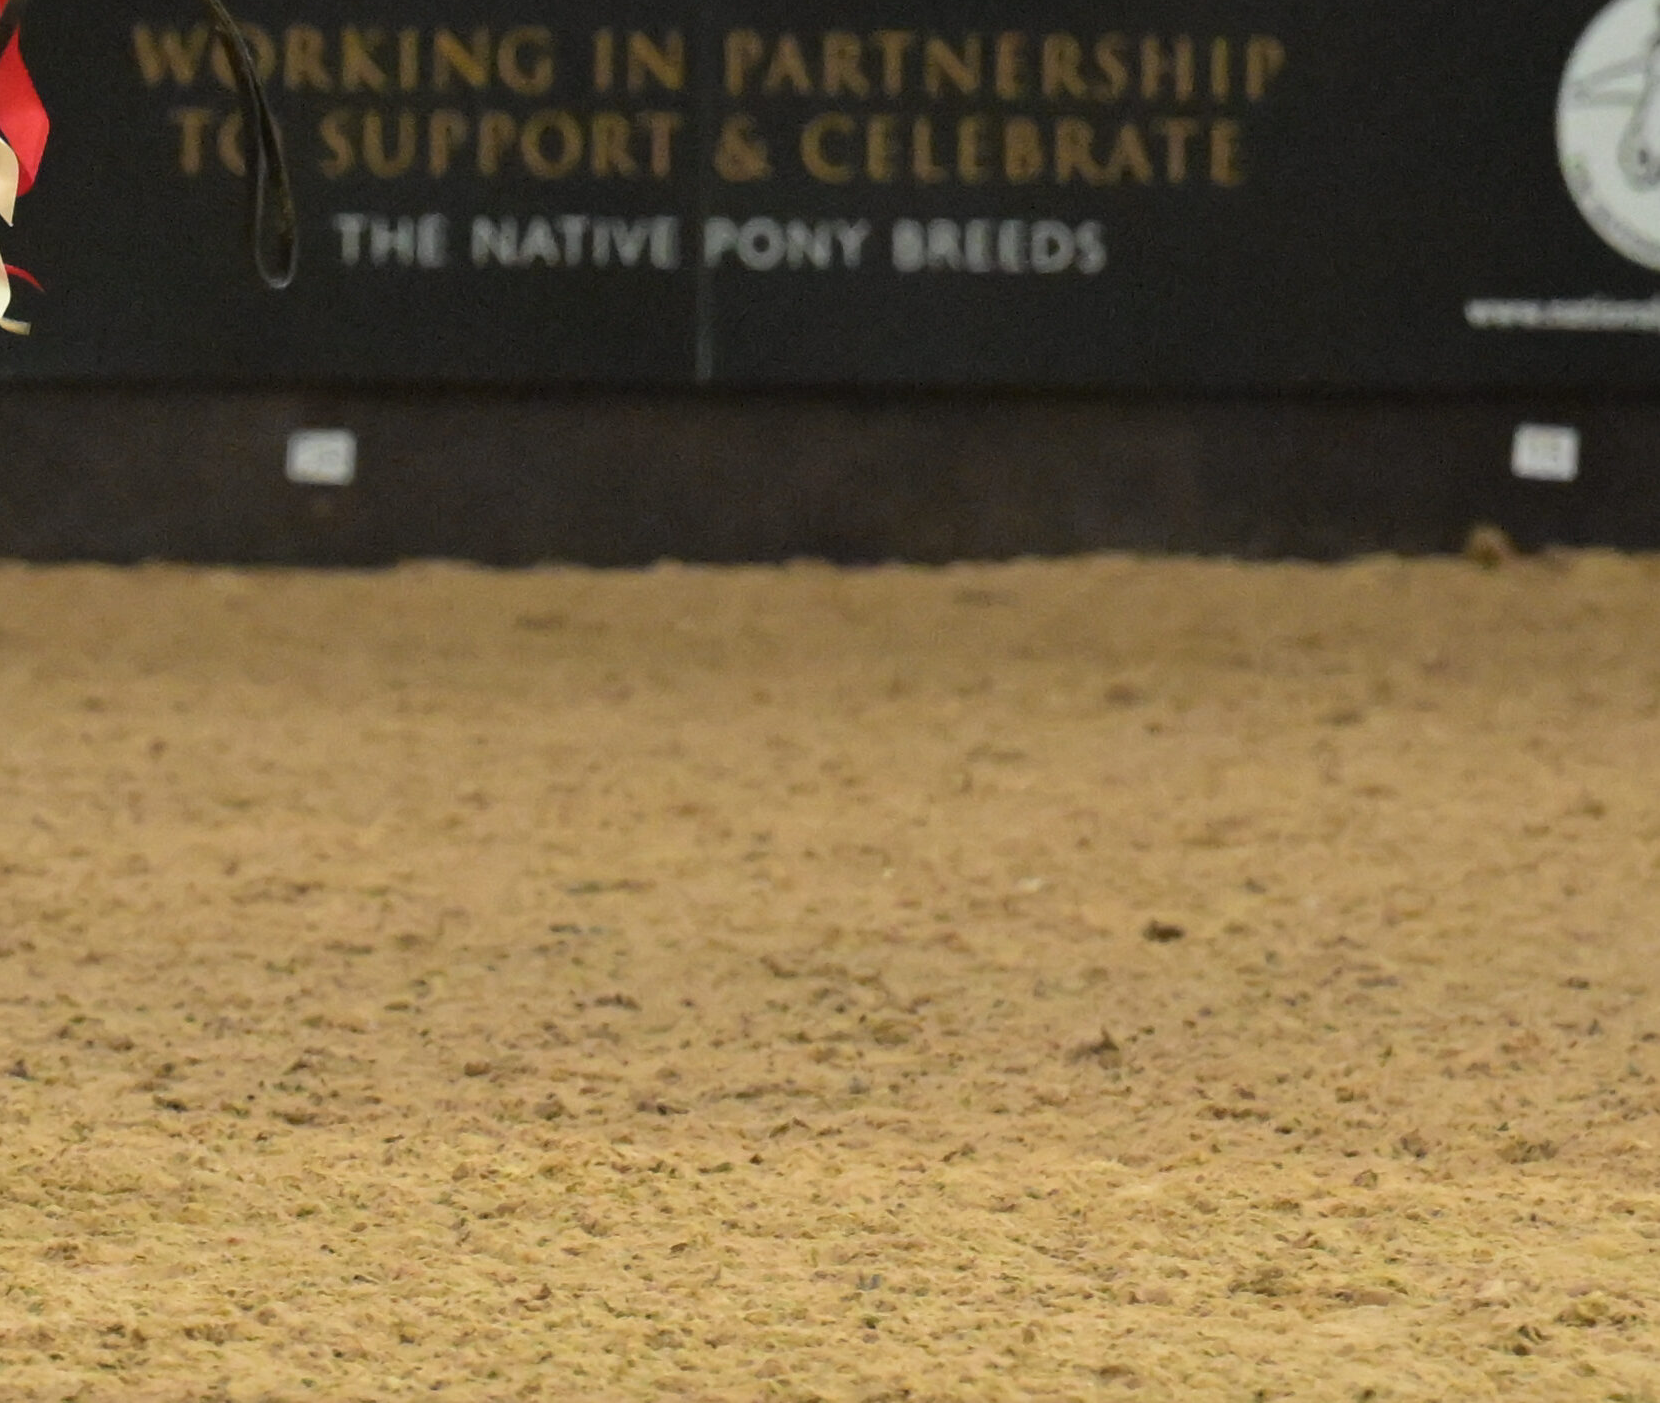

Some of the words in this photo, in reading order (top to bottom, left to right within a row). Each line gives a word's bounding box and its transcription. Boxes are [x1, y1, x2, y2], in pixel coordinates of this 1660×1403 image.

[131, 23, 555, 91] WORKING
[593, 25, 686, 92] IN
[723, 28, 1285, 101] PARTNERSHIP
[319, 107, 680, 180] SUPPORT
[712, 112, 773, 183] &
[800, 113, 1244, 187] CELEBRATE
[332, 211, 449, 268] THE
[470, 212, 679, 271] NATIVE
[703, 215, 872, 272] PONY
[891, 217, 1109, 274] BREEDS
